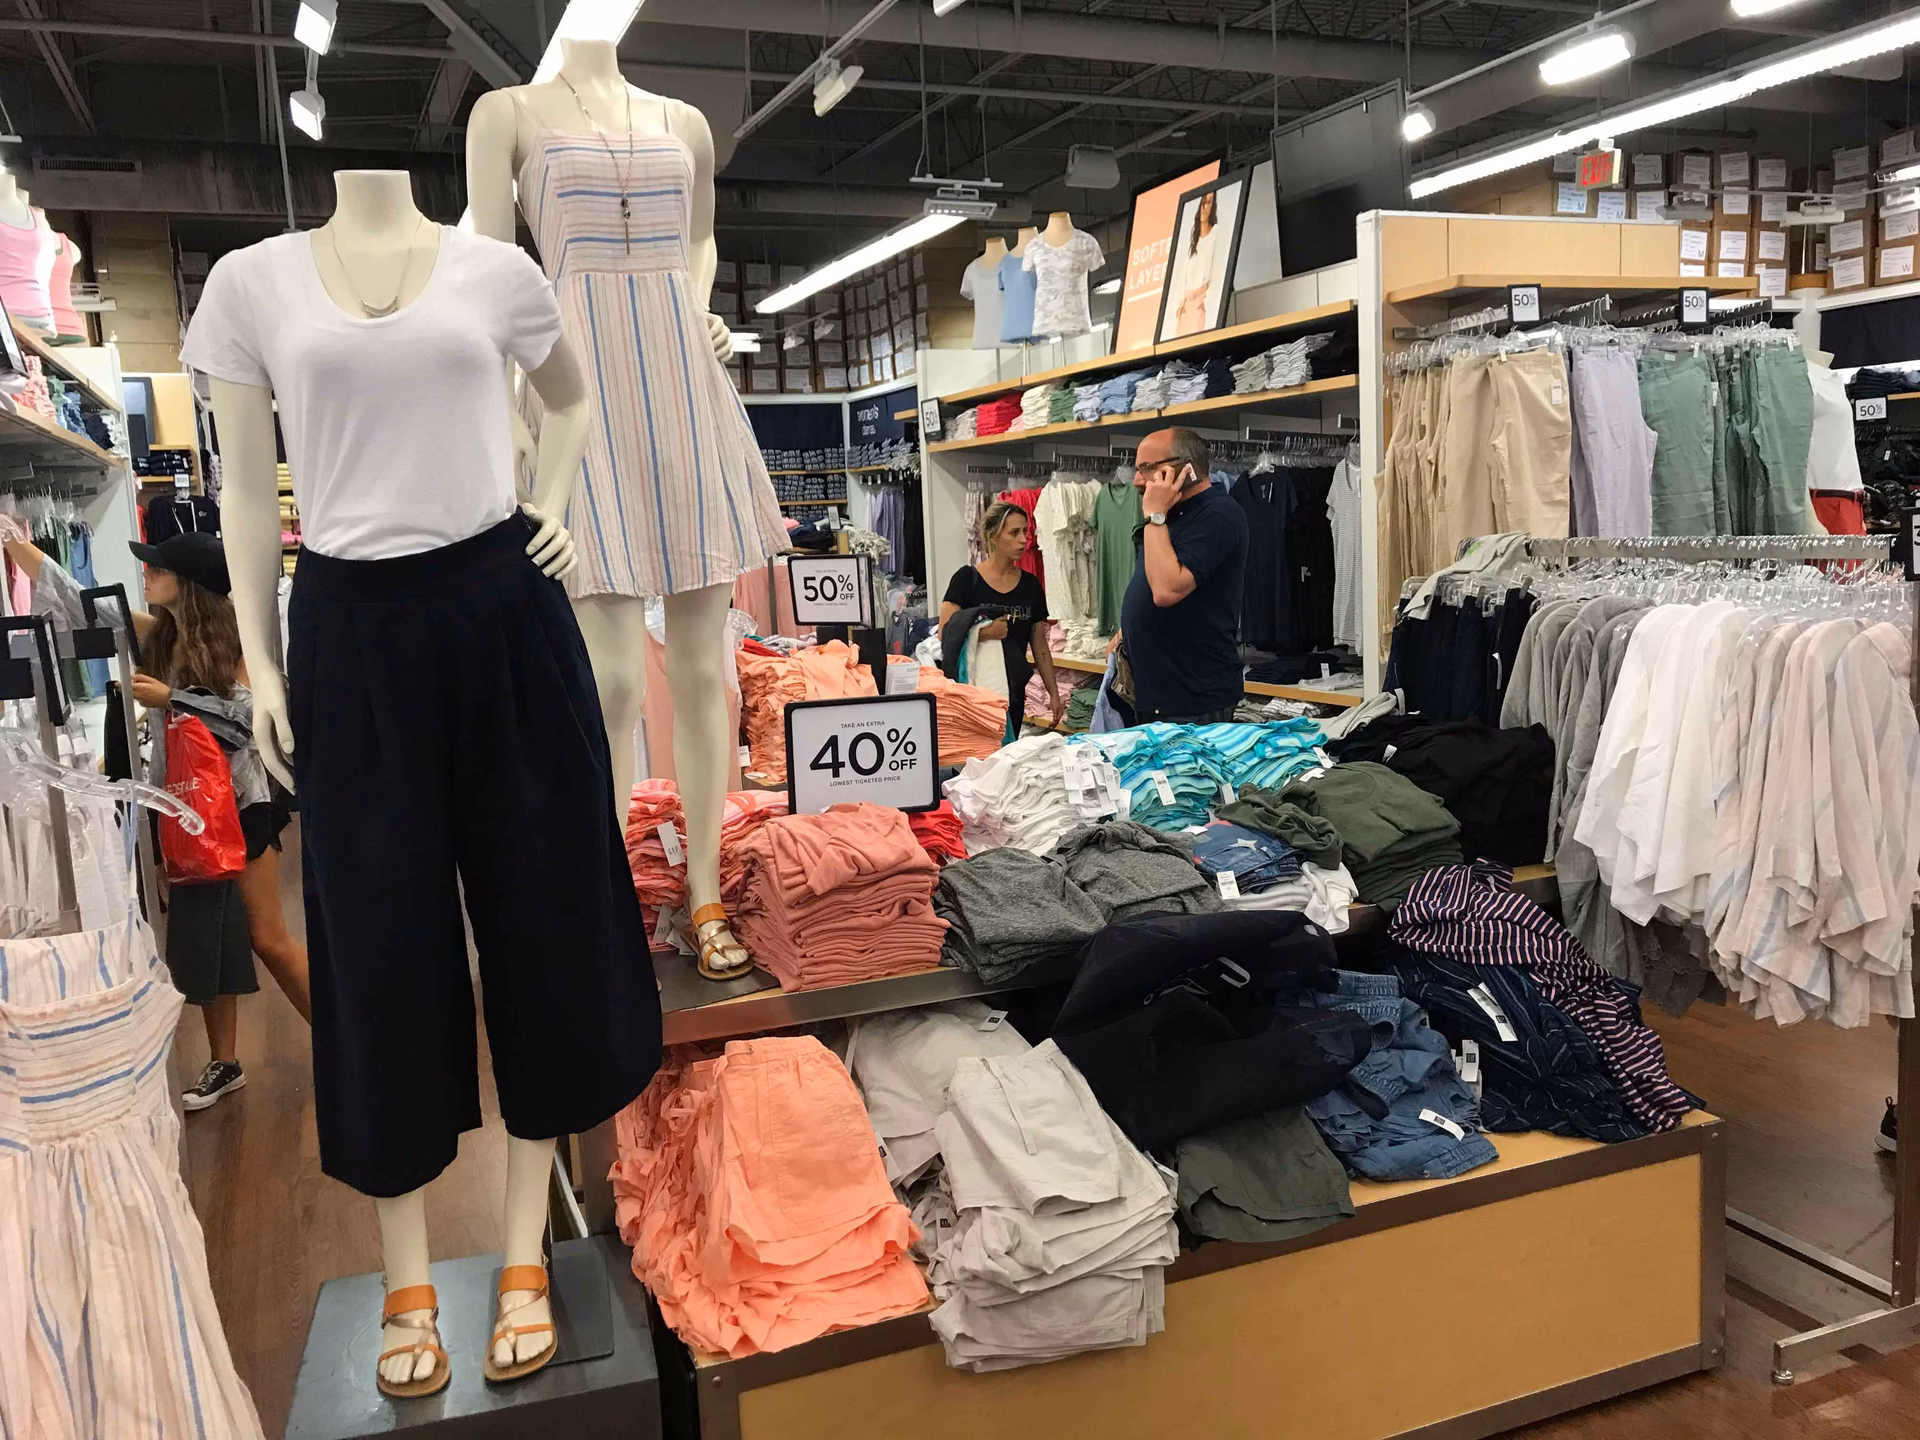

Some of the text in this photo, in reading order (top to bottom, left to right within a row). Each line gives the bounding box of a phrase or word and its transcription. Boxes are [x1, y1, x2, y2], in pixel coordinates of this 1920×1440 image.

[1581, 153, 1609, 187] EXIT
[1577, 202, 1585, 211] M
[1616, 210, 1624, 219] M
[1907, 225, 1917, 233] W
[1697, 250, 1705, 258] M
[1902, 263, 1911, 272] W
[803, 574, 854, 602] 50%
[809, 727, 917, 779] 40% OFF
[1065, 765, 1075, 773] GAP
[829, 779, 853, 787] LOWEST
[855, 777, 883, 785] TICKETED
